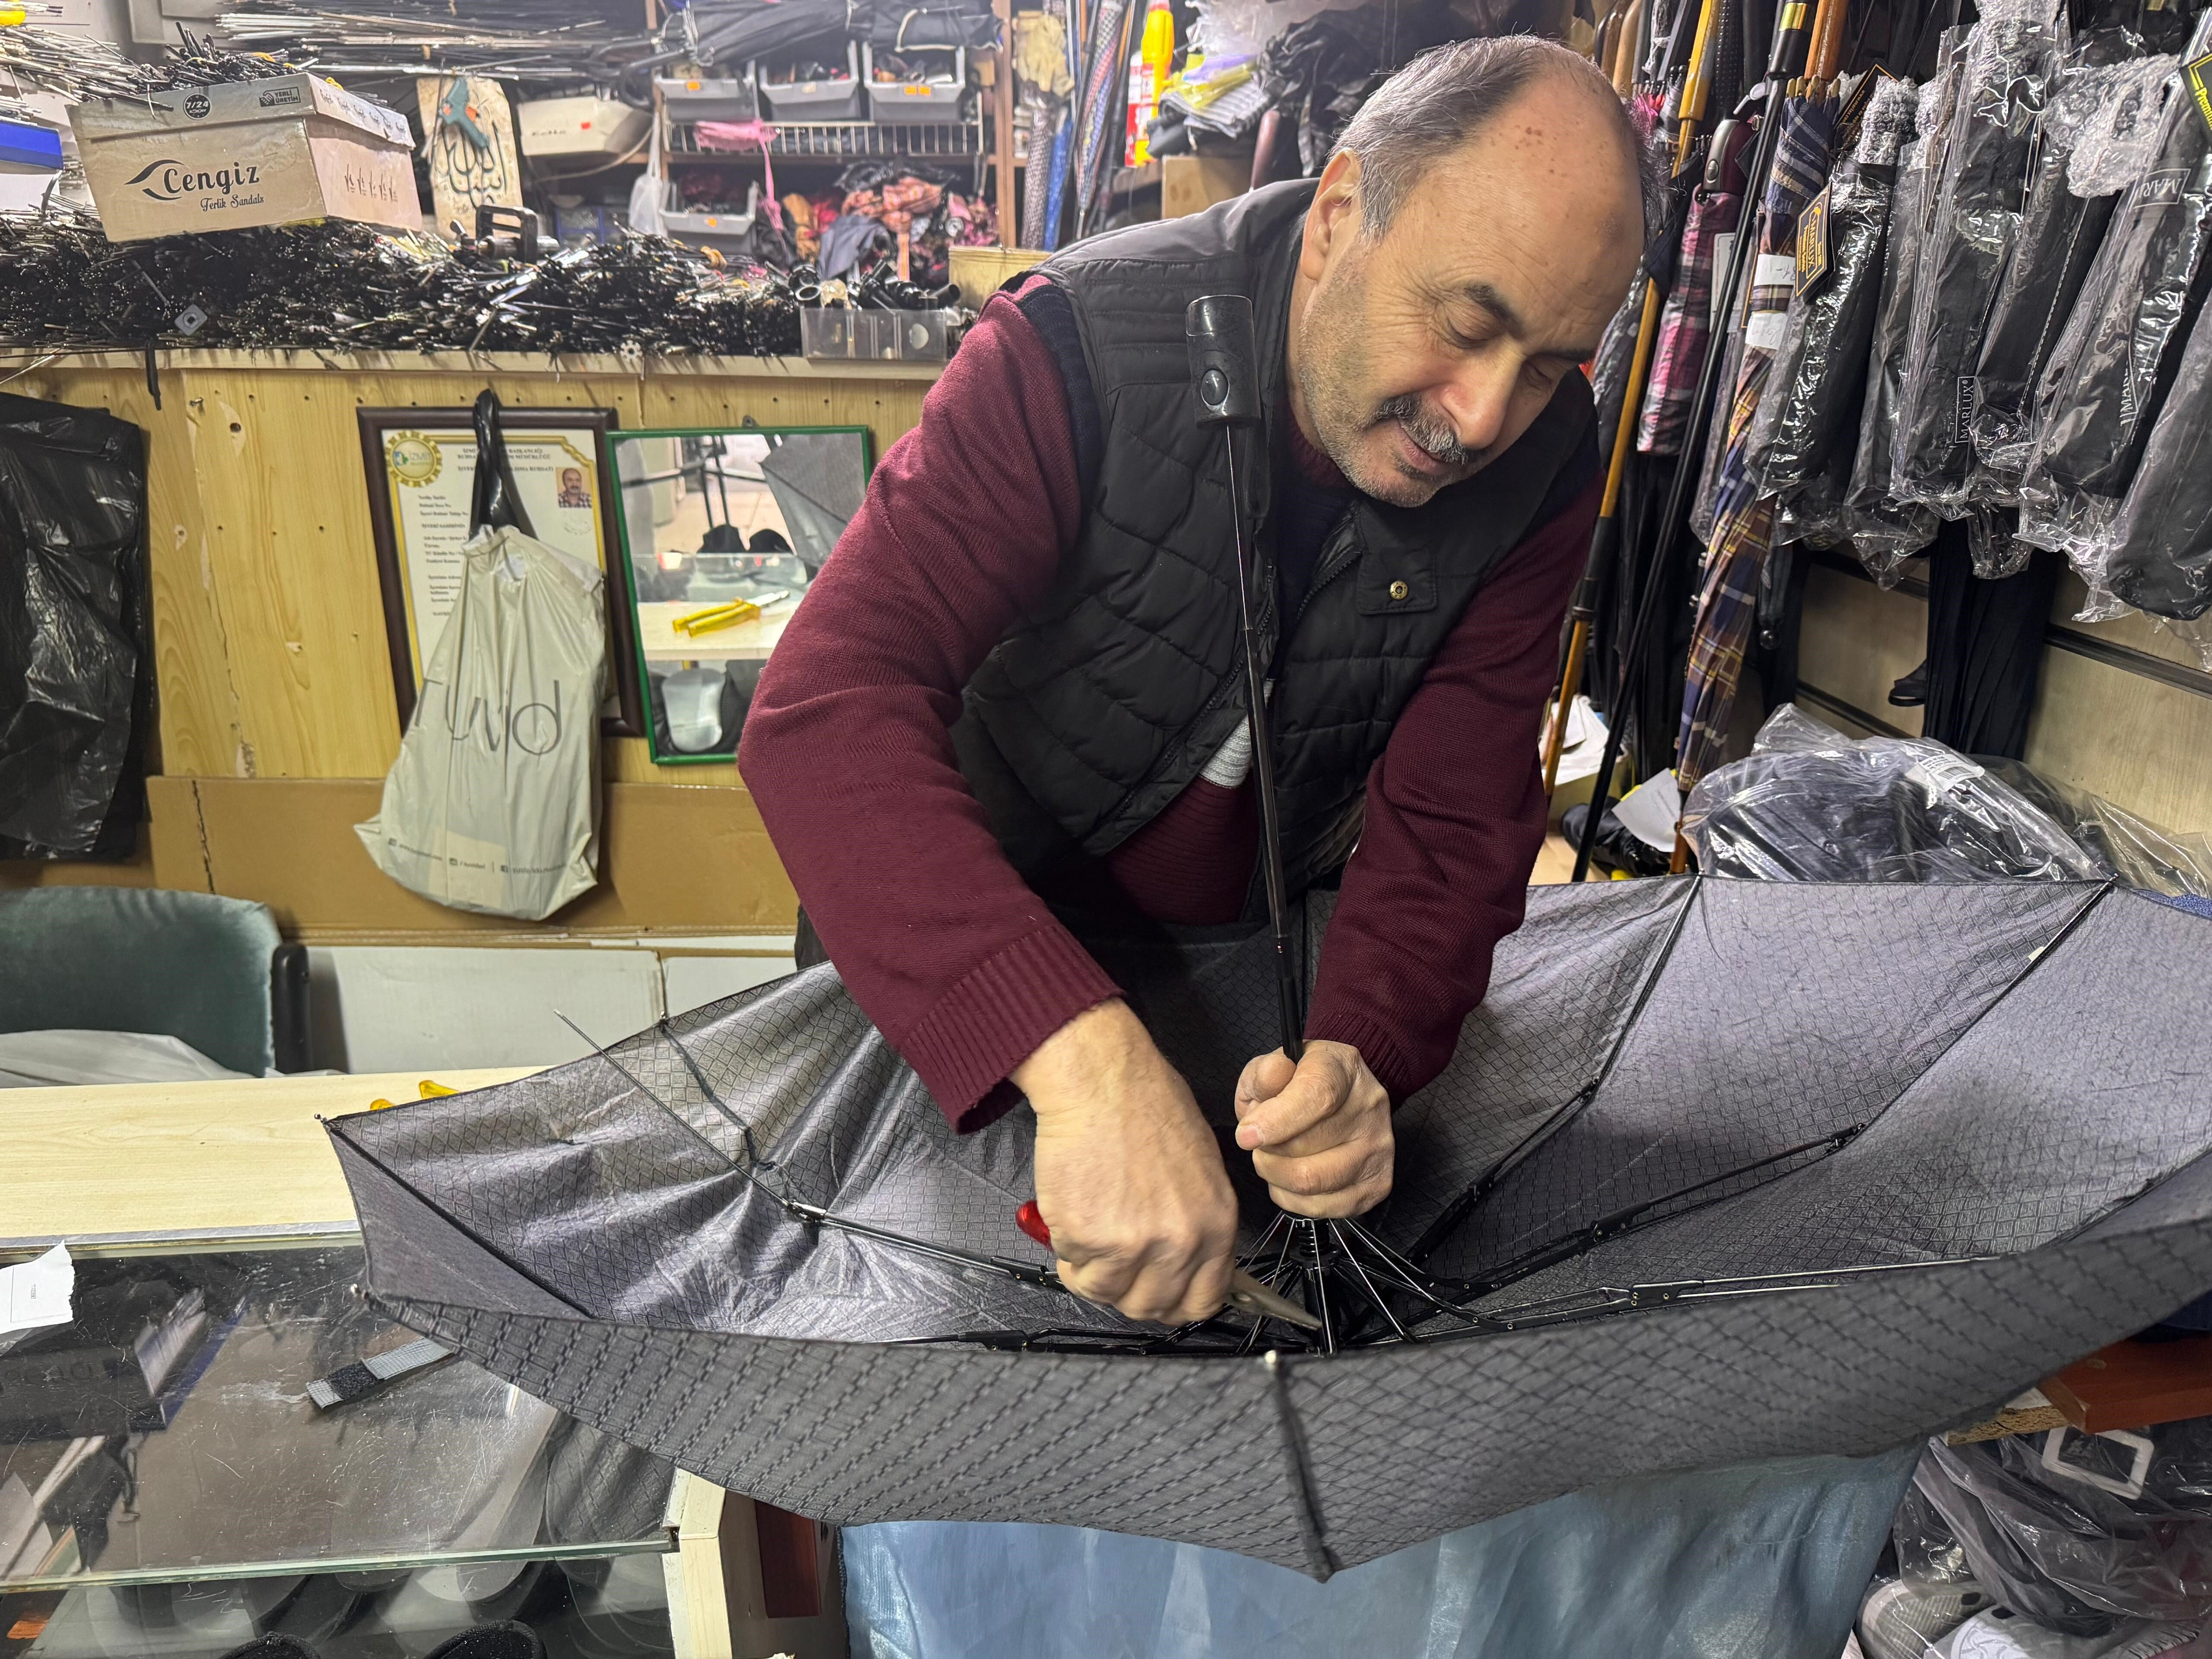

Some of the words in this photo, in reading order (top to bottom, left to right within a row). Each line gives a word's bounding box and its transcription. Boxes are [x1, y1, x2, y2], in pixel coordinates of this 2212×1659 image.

[274, 89, 292, 97] YERLİ
[186, 101, 209, 109] 7/24
[164, 162, 260, 195] Cengiz
[200, 197, 227, 213] Terlik
[1808, 219, 1817, 268] MARLUX
